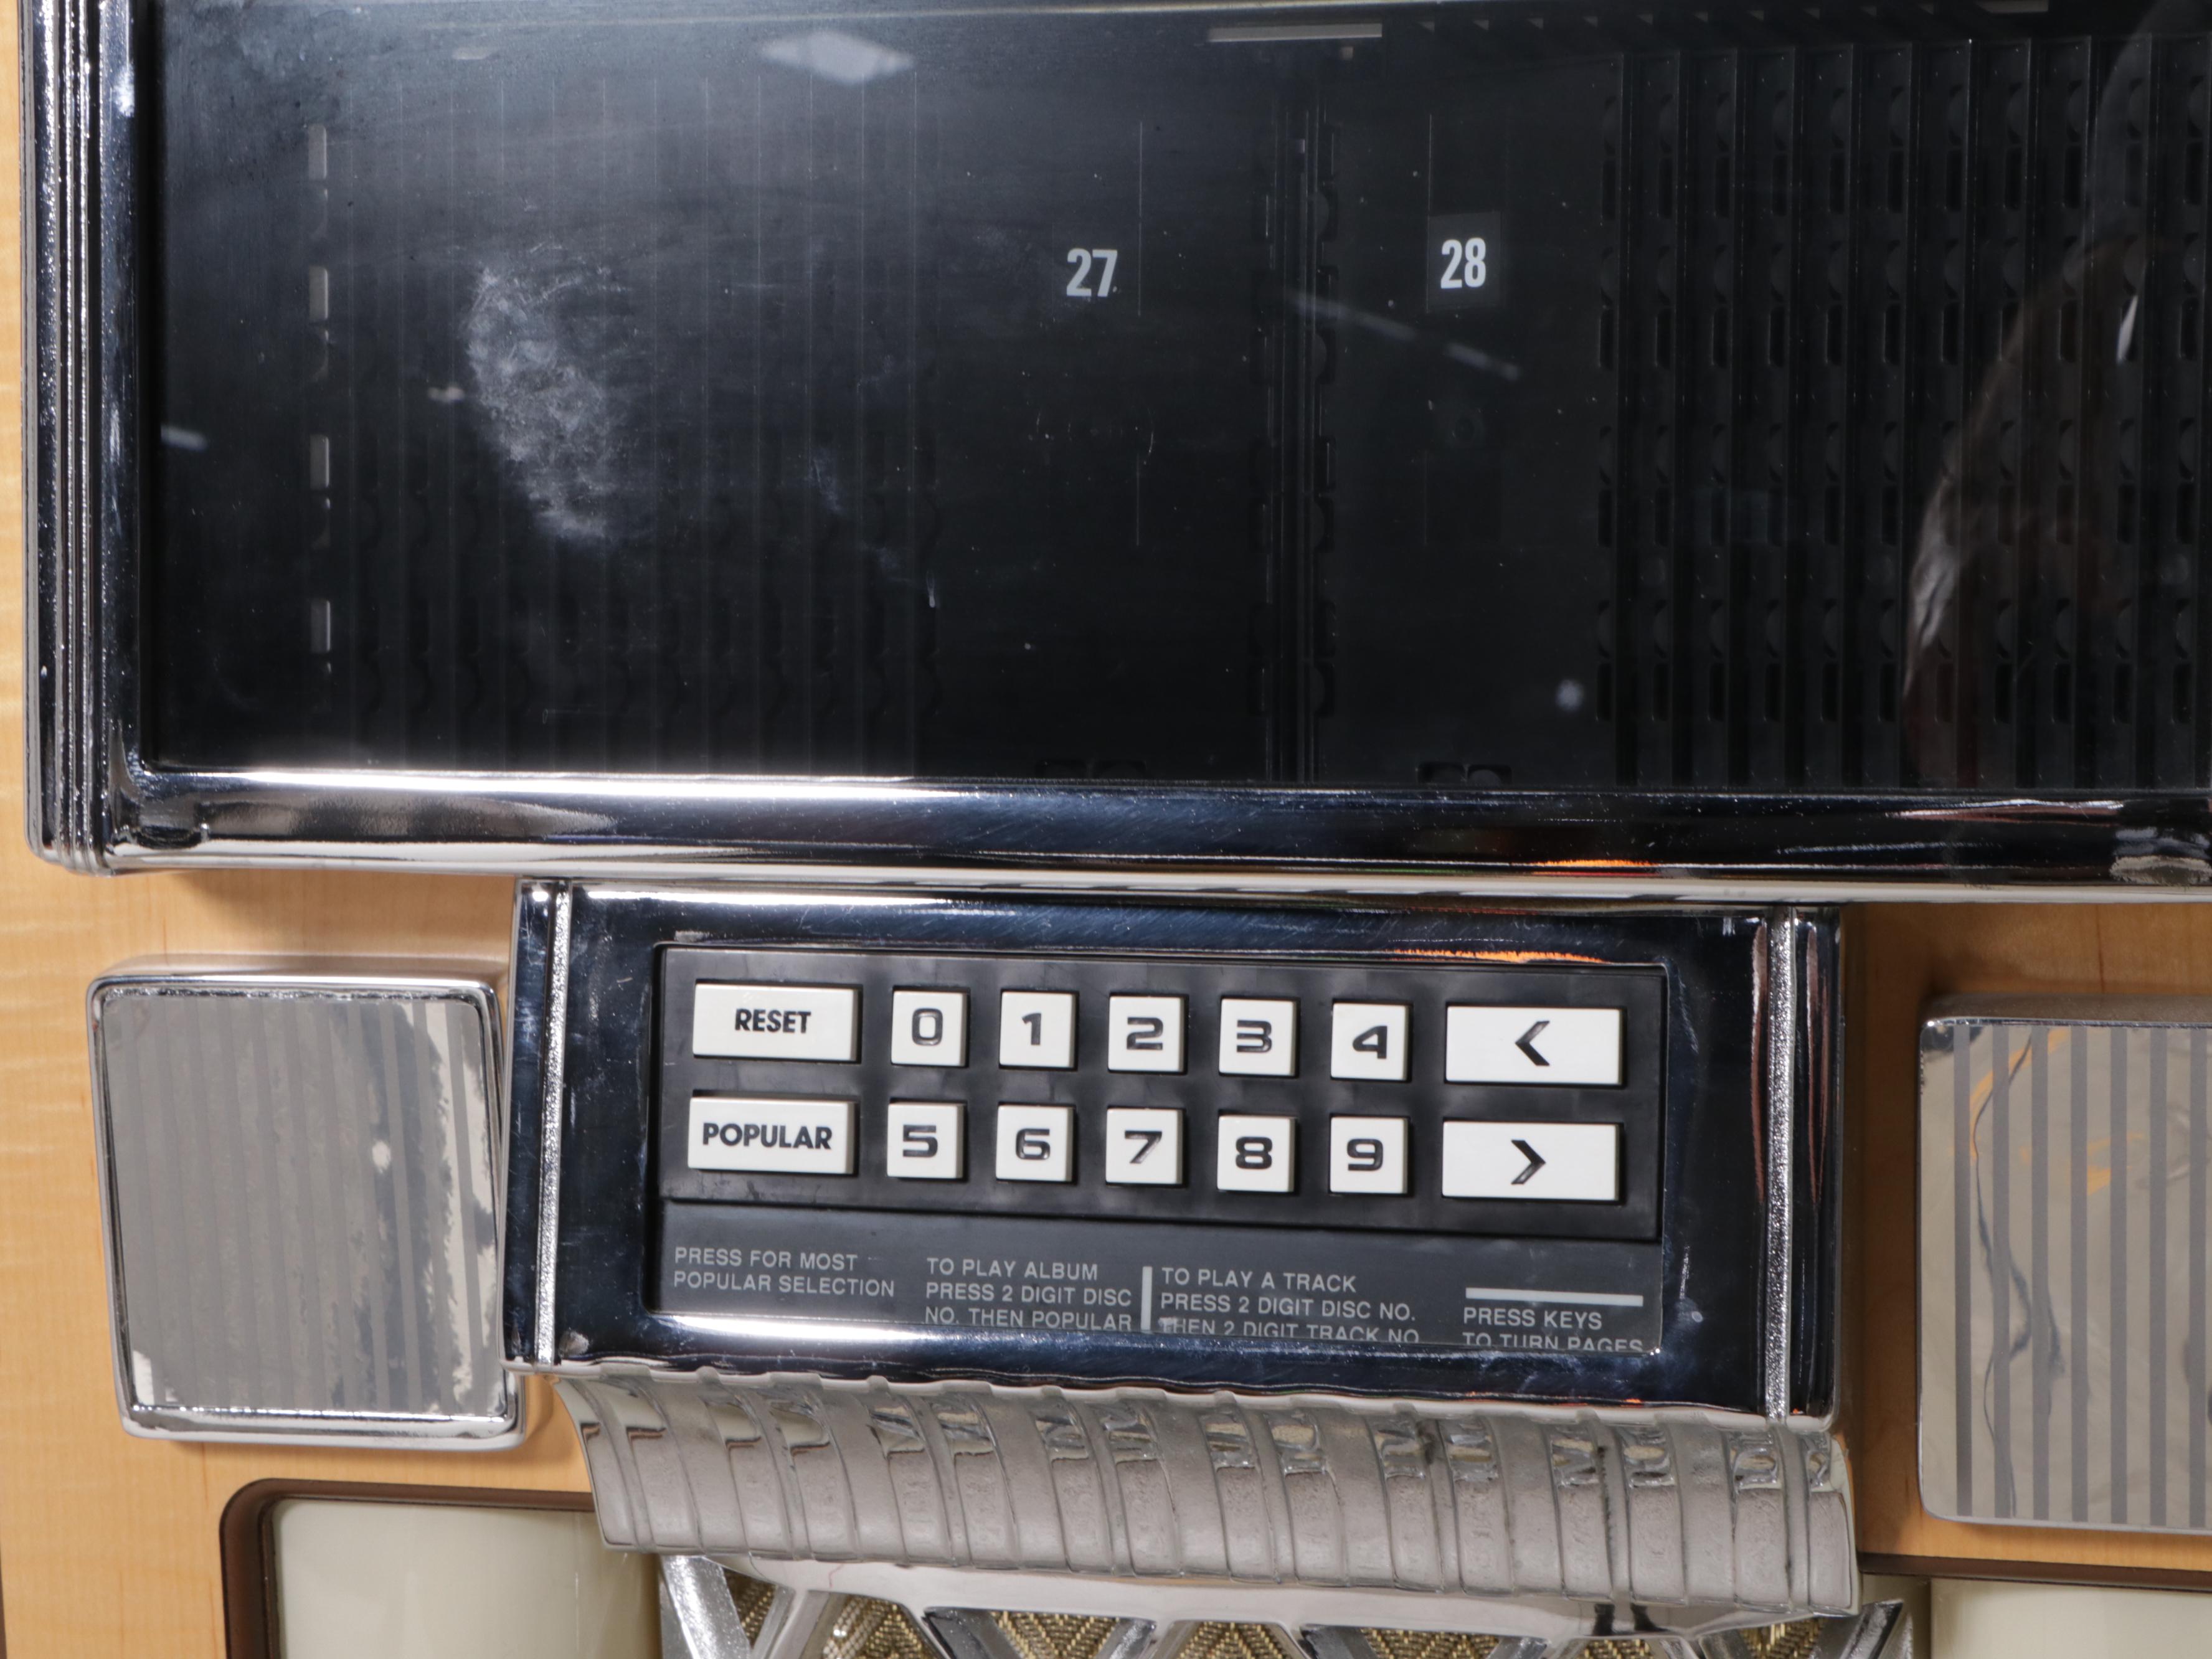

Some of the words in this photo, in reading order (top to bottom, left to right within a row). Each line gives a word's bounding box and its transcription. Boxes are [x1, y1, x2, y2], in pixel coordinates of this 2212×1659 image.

[1066, 248, 1118, 298] 27
[1440, 237, 1487, 289] 28
[734, 1008, 811, 1034] RESET
[910, 1007, 943, 1046] 0
[1021, 1012, 1042, 1046] 1
[1126, 1017, 1163, 1051] 2
[1236, 1019, 1273, 1054] 3
[1352, 1024, 1388, 1059] 4
[702, 1122, 832, 1150] POPULAR
[902, 1124, 939, 1158] 5
[1015, 1128, 1051, 1160] 6
[1124, 1130, 1163, 1164] 7
[1235, 1136, 1273, 1171] 8
[1346, 1137, 1383, 1171] 9
[674, 1247, 742, 1267] PRESS
[750, 1250, 792, 1269] FOR
[800, 1252, 858, 1272] MOST
[927, 1257, 955, 1275] TO
[962, 1258, 1016, 1278] PLAY
[1024, 1260, 1099, 1281] ALBUM
[673, 1271, 772, 1293] POPULAR
[778, 1274, 895, 1298] SELECTION
[926, 1282, 995, 1302] PRESS
[1002, 1285, 1013, 1303] 2
[1020, 1286, 1077, 1305] DIGIT
[1082, 1288, 1132, 1307] DISC
[1161, 1267, 1190, 1285] TO
[1198, 1269, 1252, 1288] PLAY
[1260, 1272, 1277, 1289] A
[1283, 1272, 1357, 1293] TRACK
[924, 1307, 959, 1326] NO.
[968, 1308, 1025, 1328] THEN
[1031, 1311, 1132, 1332] POPULAR
[1161, 1293, 1231, 1313] PRESS
[1238, 1295, 1250, 1314] 2
[1258, 1297, 1312, 1316] DIGIT
[1321, 1300, 1373, 1320] DISC
[1378, 1302, 1416, 1322] NO.
[1463, 1307, 1536, 1327] PRESS
[1544, 1310, 1602, 1330] KEYS
[1158, 1317, 1215, 1335] THEN
[1224, 1321, 1235, 1335] 2
[1244, 1321, 1300, 1338] DIGIT
[1307, 1325, 1380, 1341] TRACK
[1462, 1332, 1491, 1346] TO
[1500, 1333, 1558, 1349] TURN
[1567, 1337, 1643, 1352] PAGES
